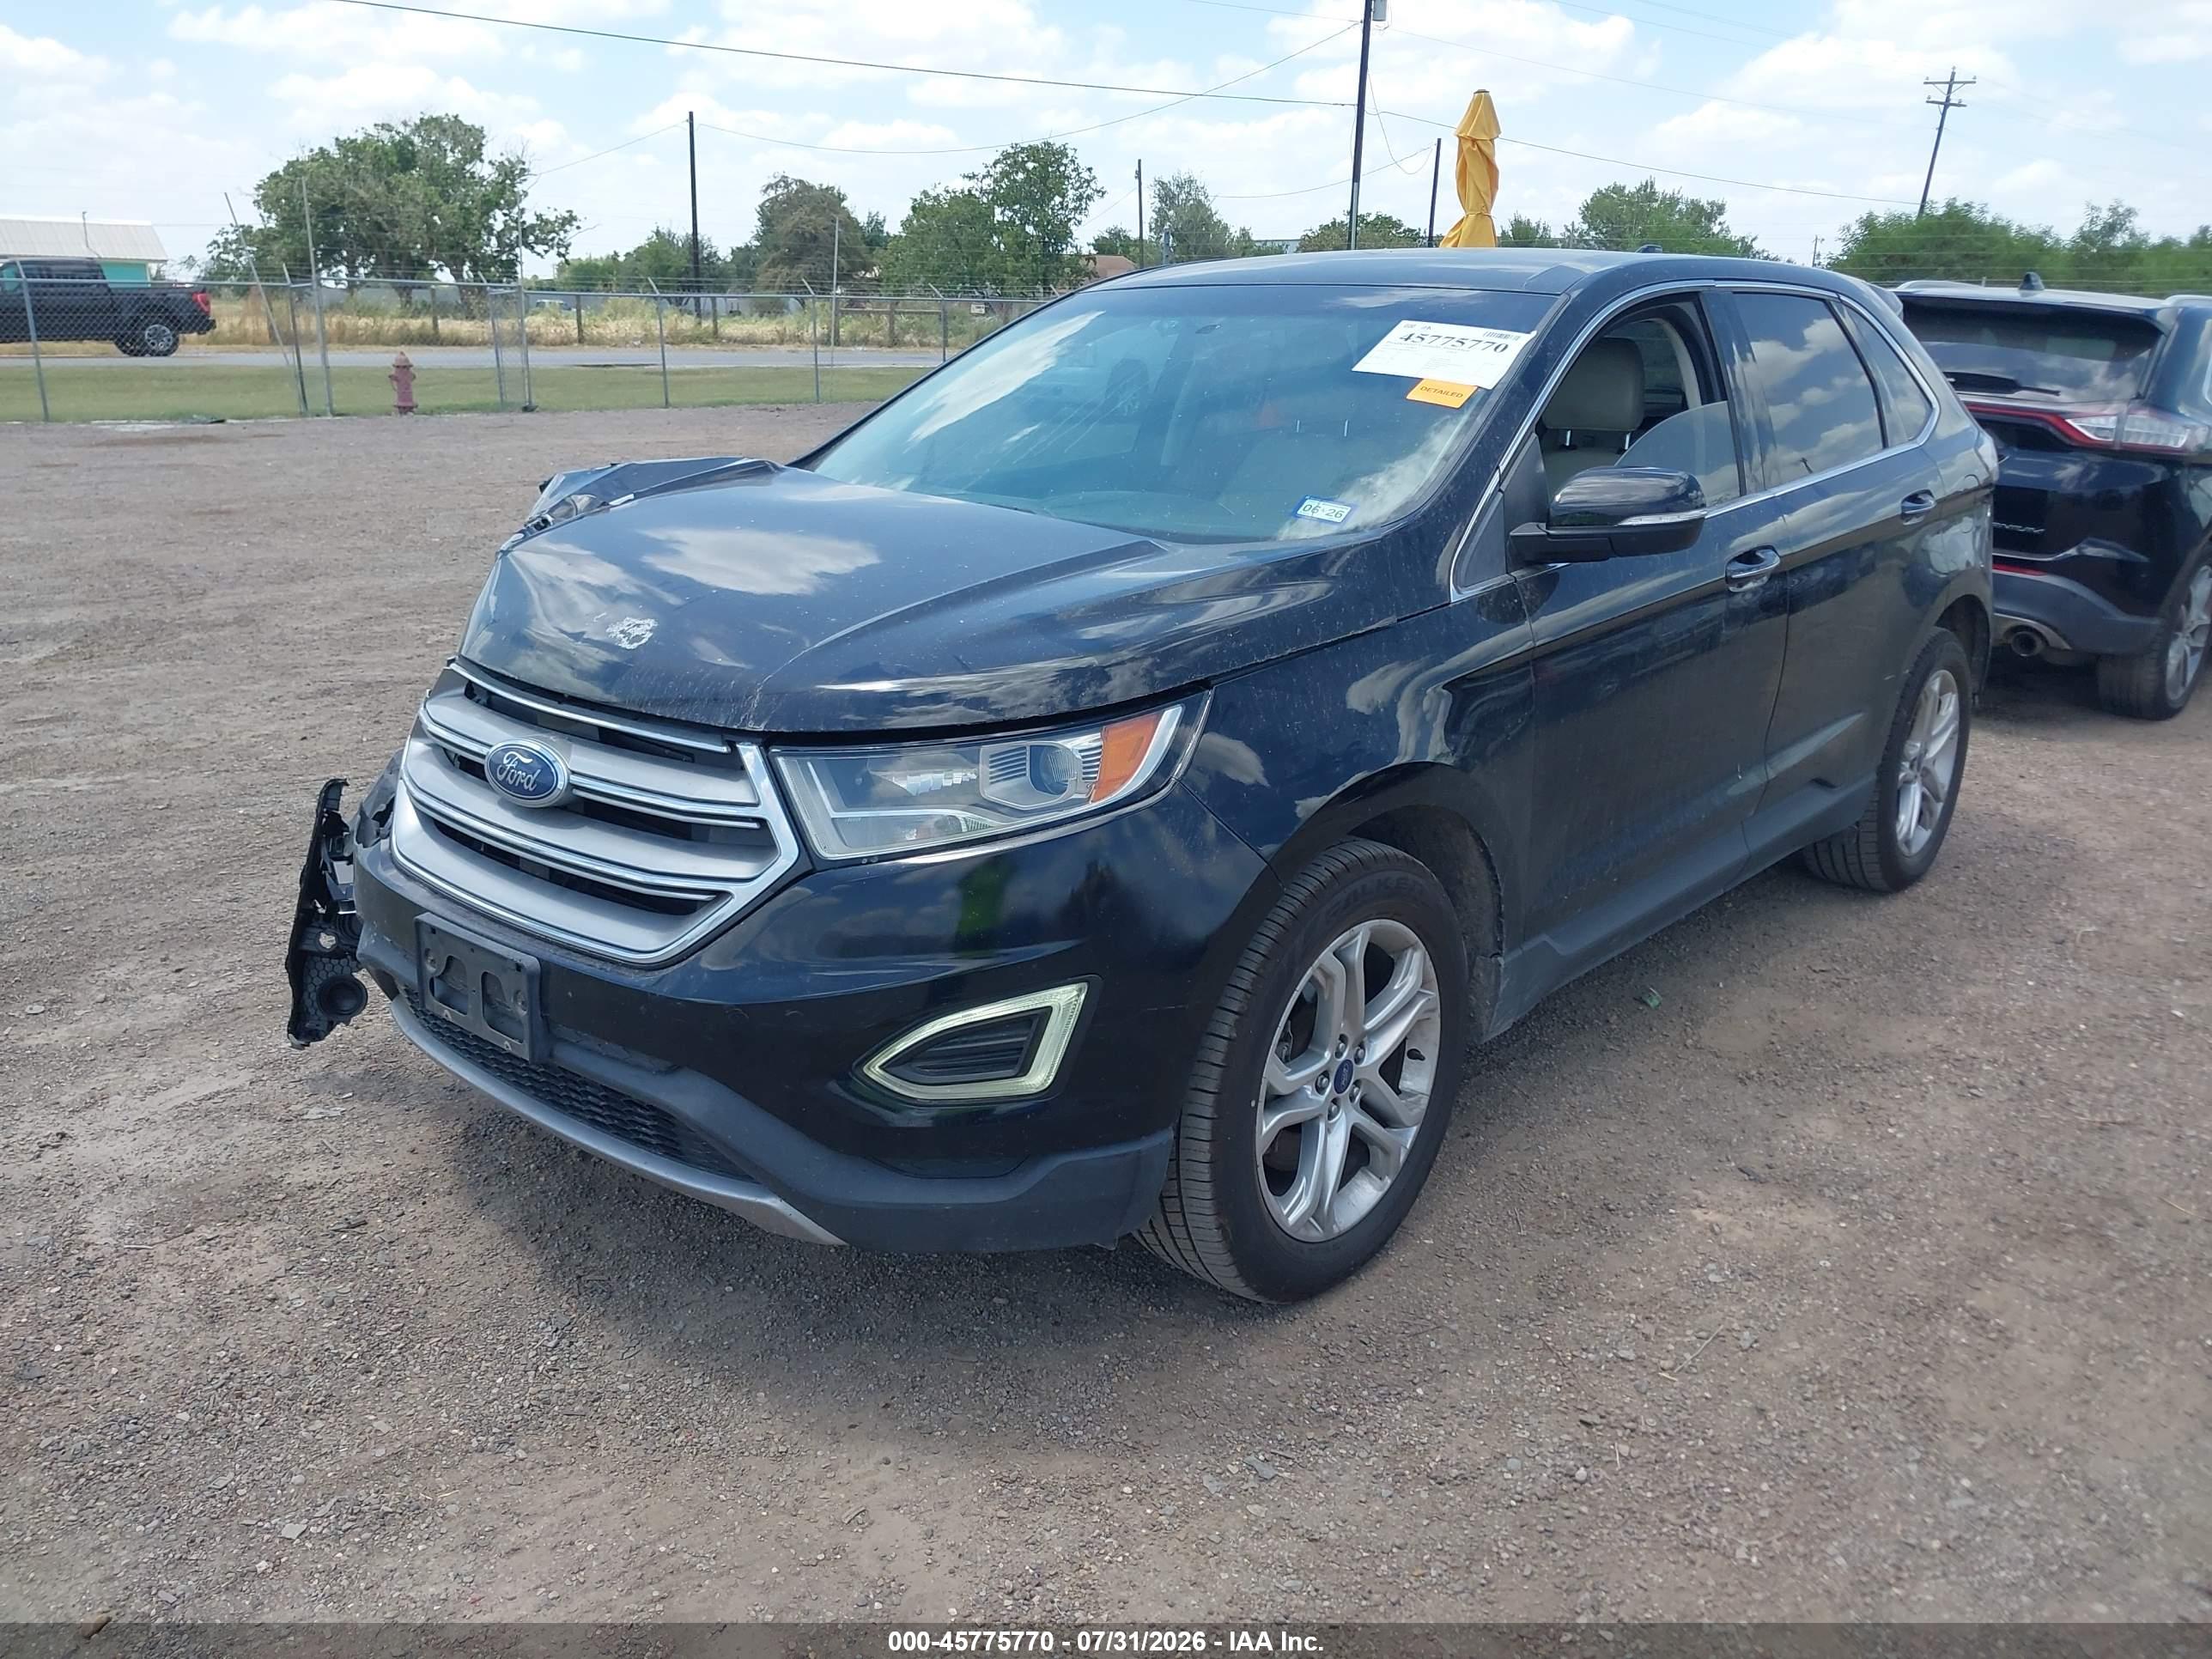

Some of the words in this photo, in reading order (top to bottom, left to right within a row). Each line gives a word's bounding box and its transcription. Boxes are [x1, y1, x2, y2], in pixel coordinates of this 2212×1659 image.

[1400, 332, 1509, 353] 45775770
[1419, 386, 1464, 398] DETAILED
[496, 750, 542, 792] Ford
